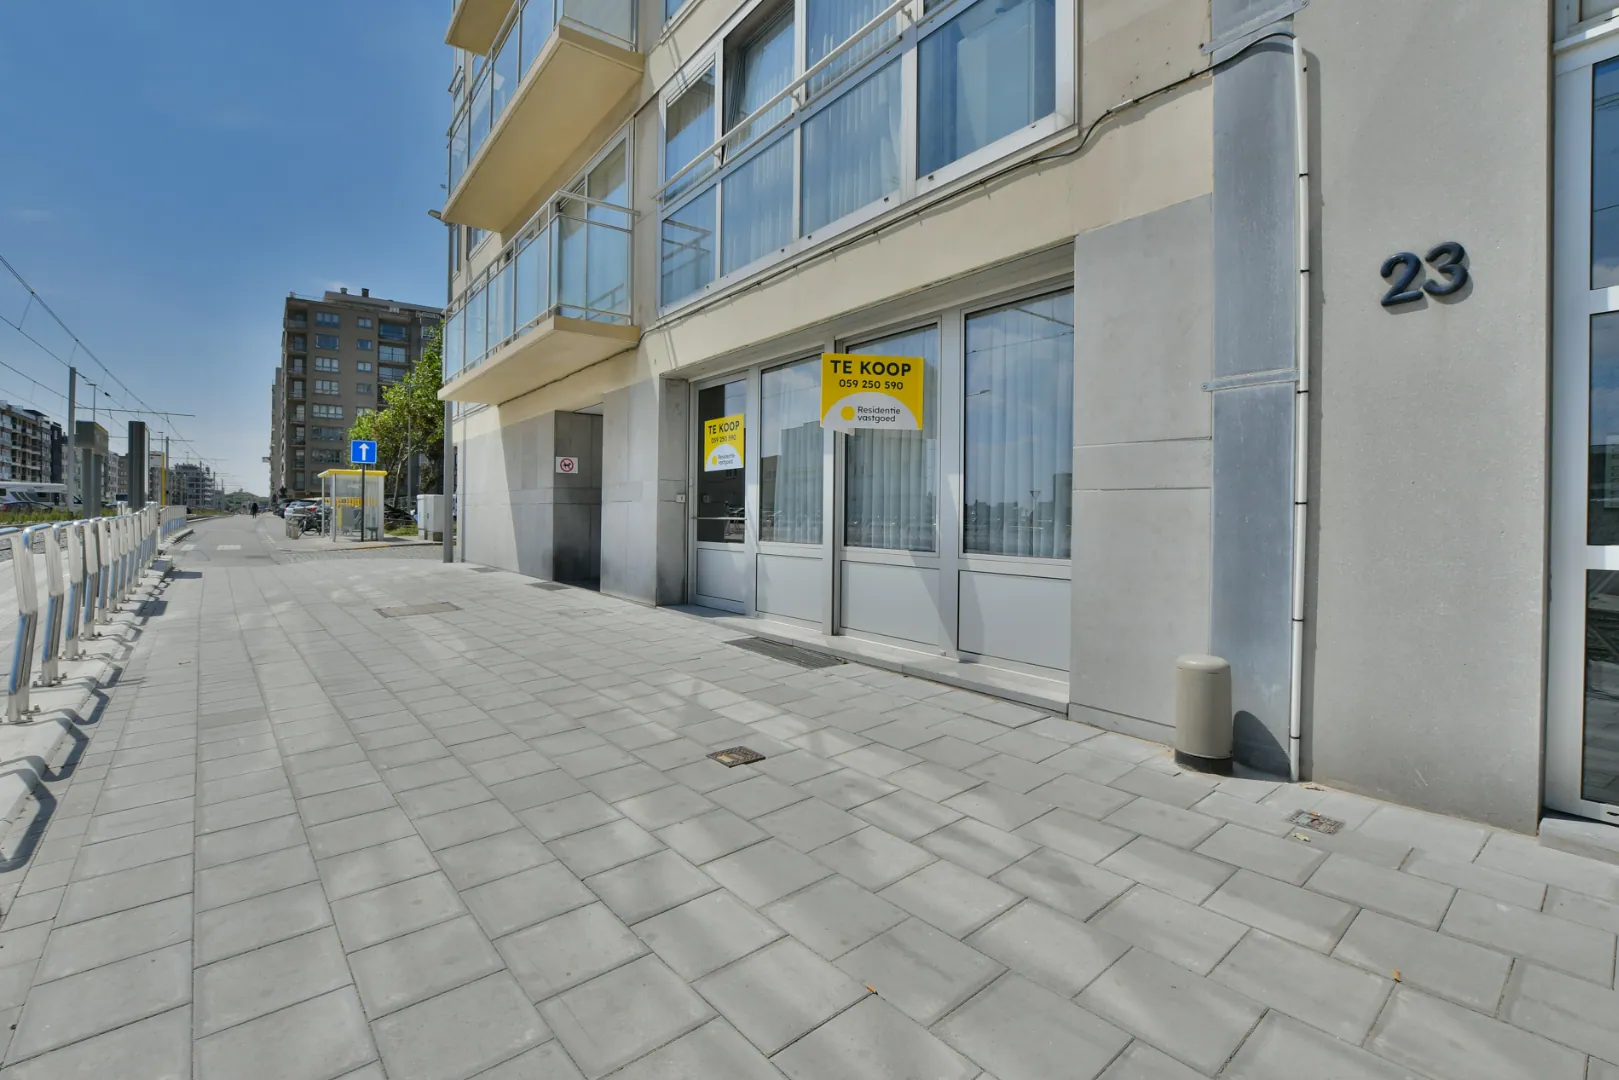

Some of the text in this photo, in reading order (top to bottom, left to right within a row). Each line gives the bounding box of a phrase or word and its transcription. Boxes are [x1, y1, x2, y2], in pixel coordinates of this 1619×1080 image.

[1381, 241, 1468, 307] 23
[830, 360, 911, 376] TE KOOP
[839, 379, 903, 390] 059 250 590
[857, 406, 900, 415] Residentie
[857, 415, 896, 424] vastgoed
[708, 421, 740, 435] TE KOOP
